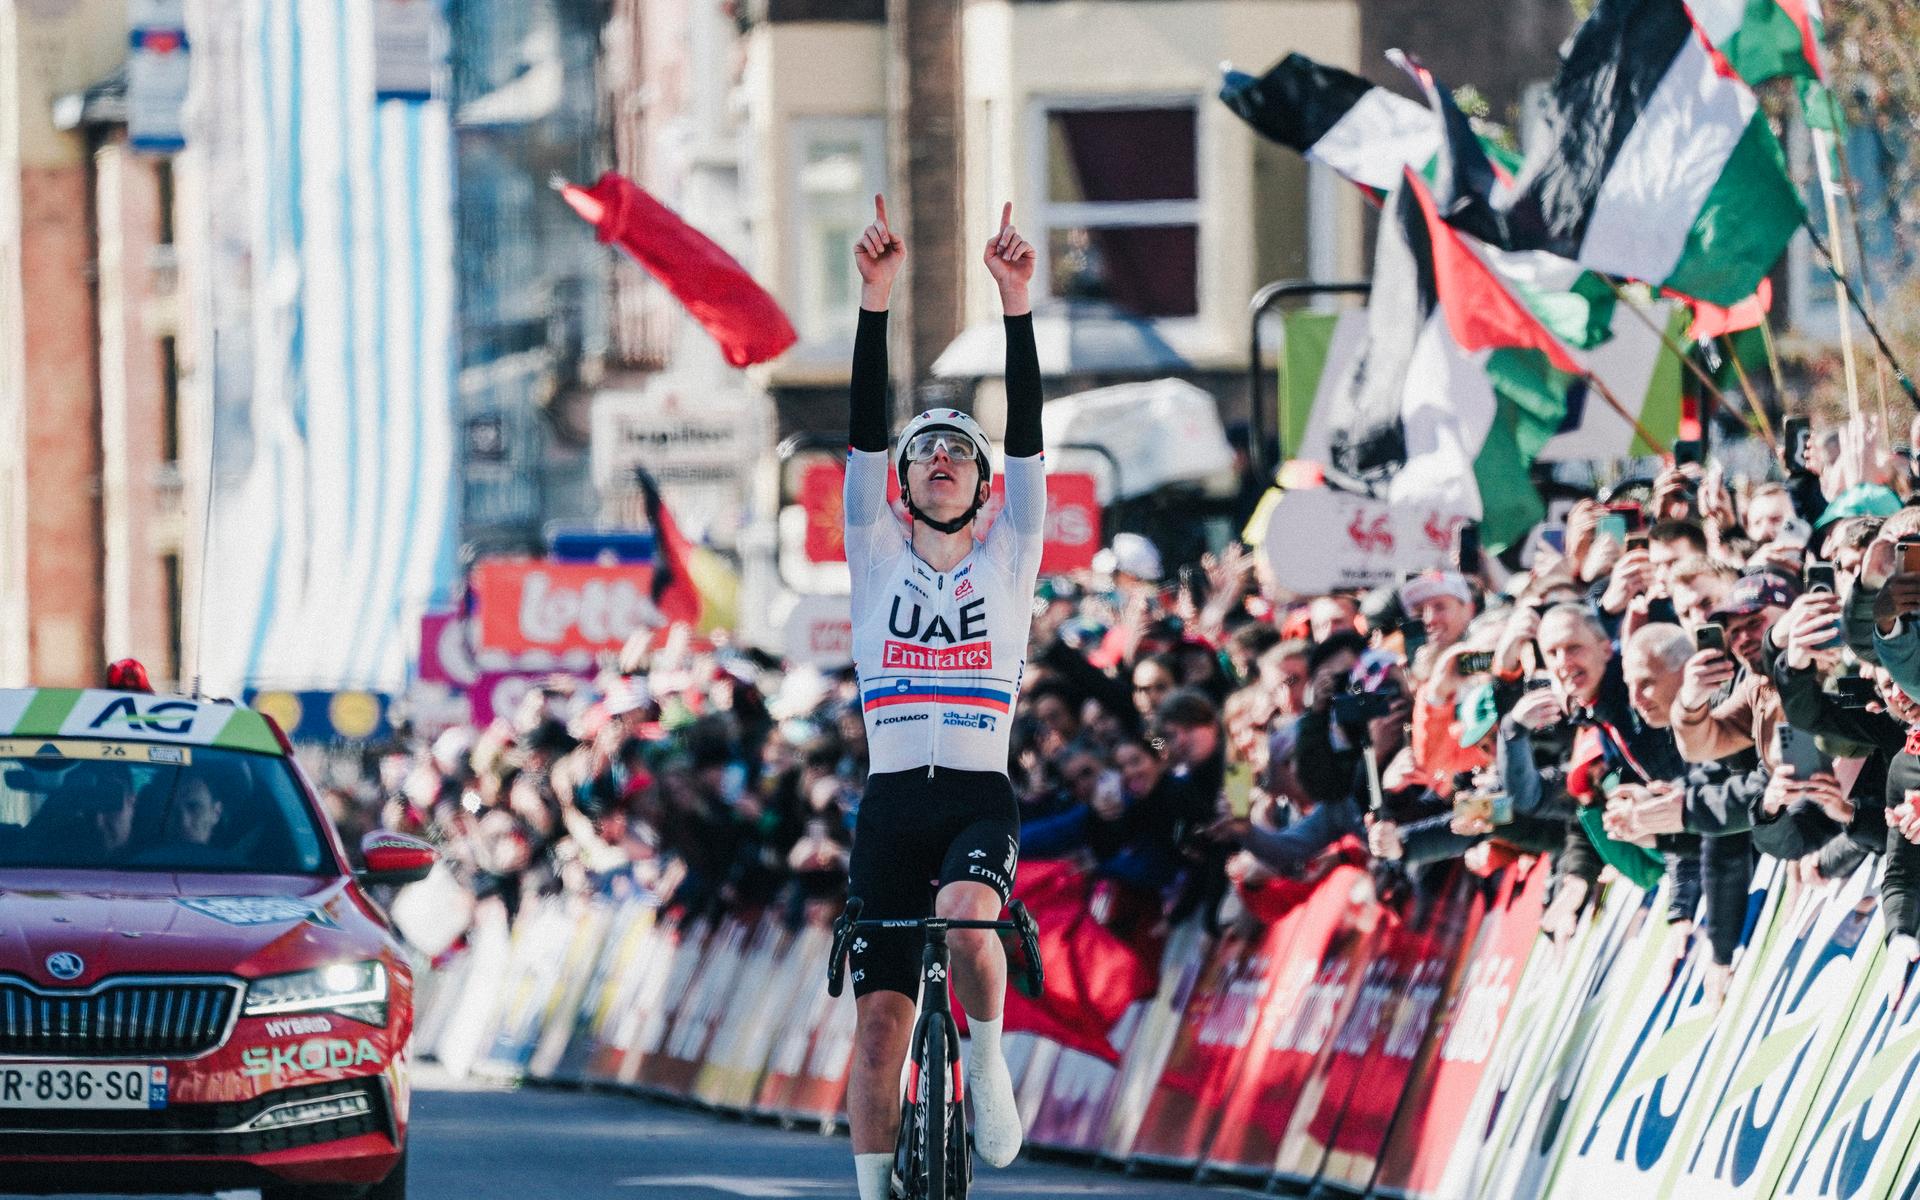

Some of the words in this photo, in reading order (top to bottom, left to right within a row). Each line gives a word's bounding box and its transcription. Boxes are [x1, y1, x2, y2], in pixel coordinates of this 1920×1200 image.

[889, 595, 987, 644] UAE
[886, 644, 989, 667] Emirates
[88, 697, 199, 734] AG
[883, 714, 928, 725] COLNAGO
[943, 718, 978, 728] ADNOC
[101, 746, 126, 756] 26
[265, 1016, 332, 1038] HYBRID
